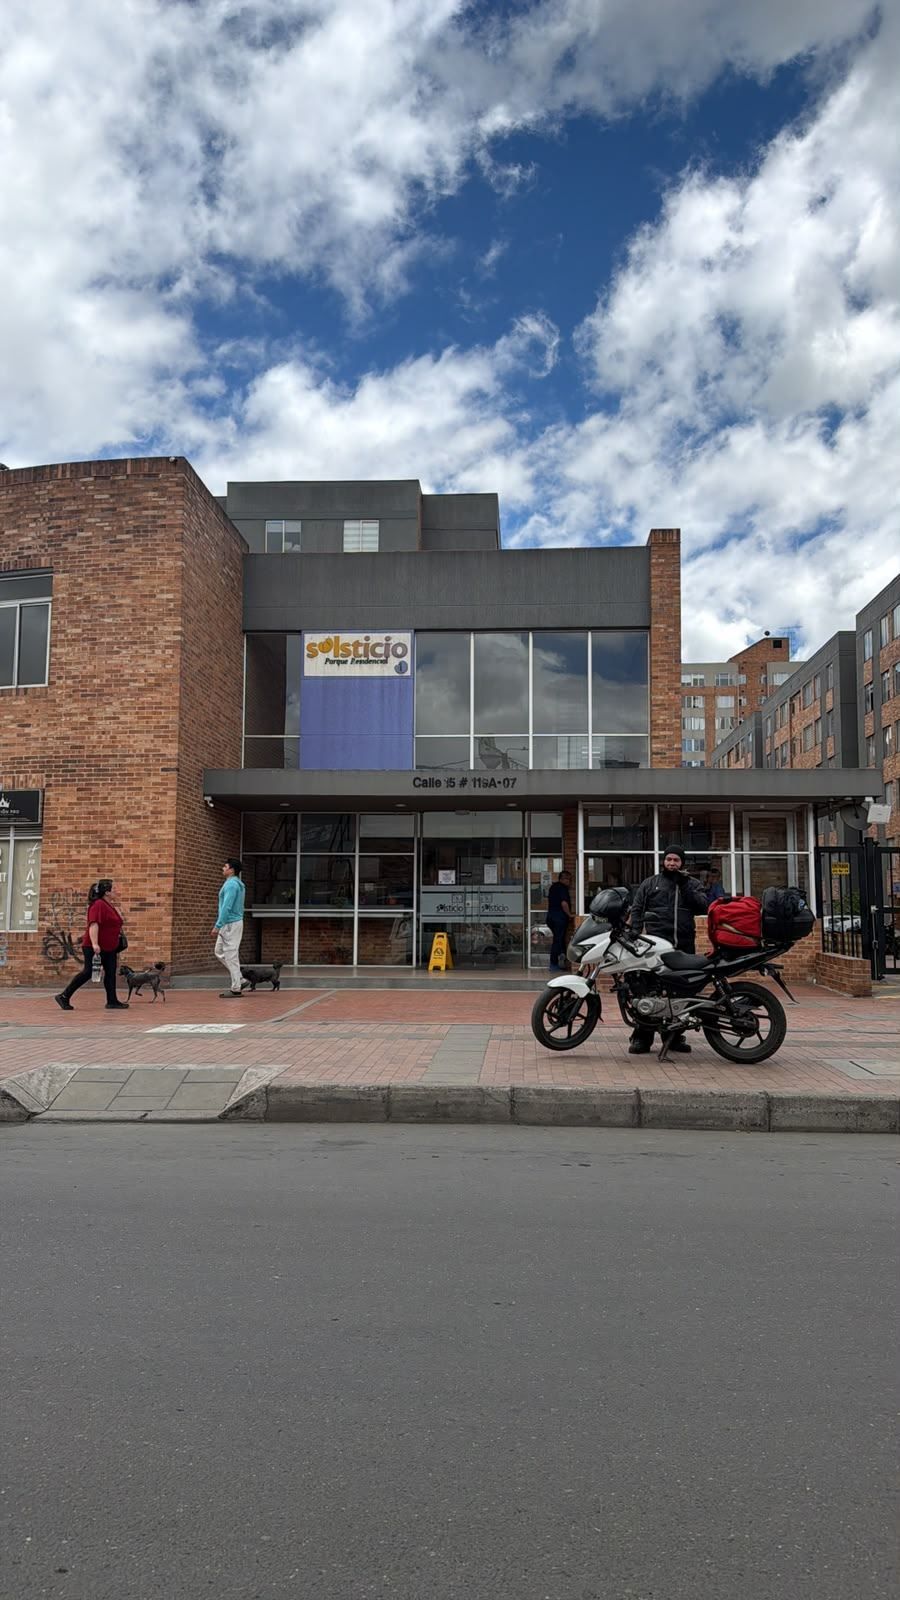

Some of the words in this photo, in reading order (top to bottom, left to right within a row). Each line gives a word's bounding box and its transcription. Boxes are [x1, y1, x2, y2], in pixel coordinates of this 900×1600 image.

[306, 635, 408, 658] solsticio
[324, 658, 348, 666] Parque
[412, 776, 442, 789] Calle
[459, 776, 468, 788] #
